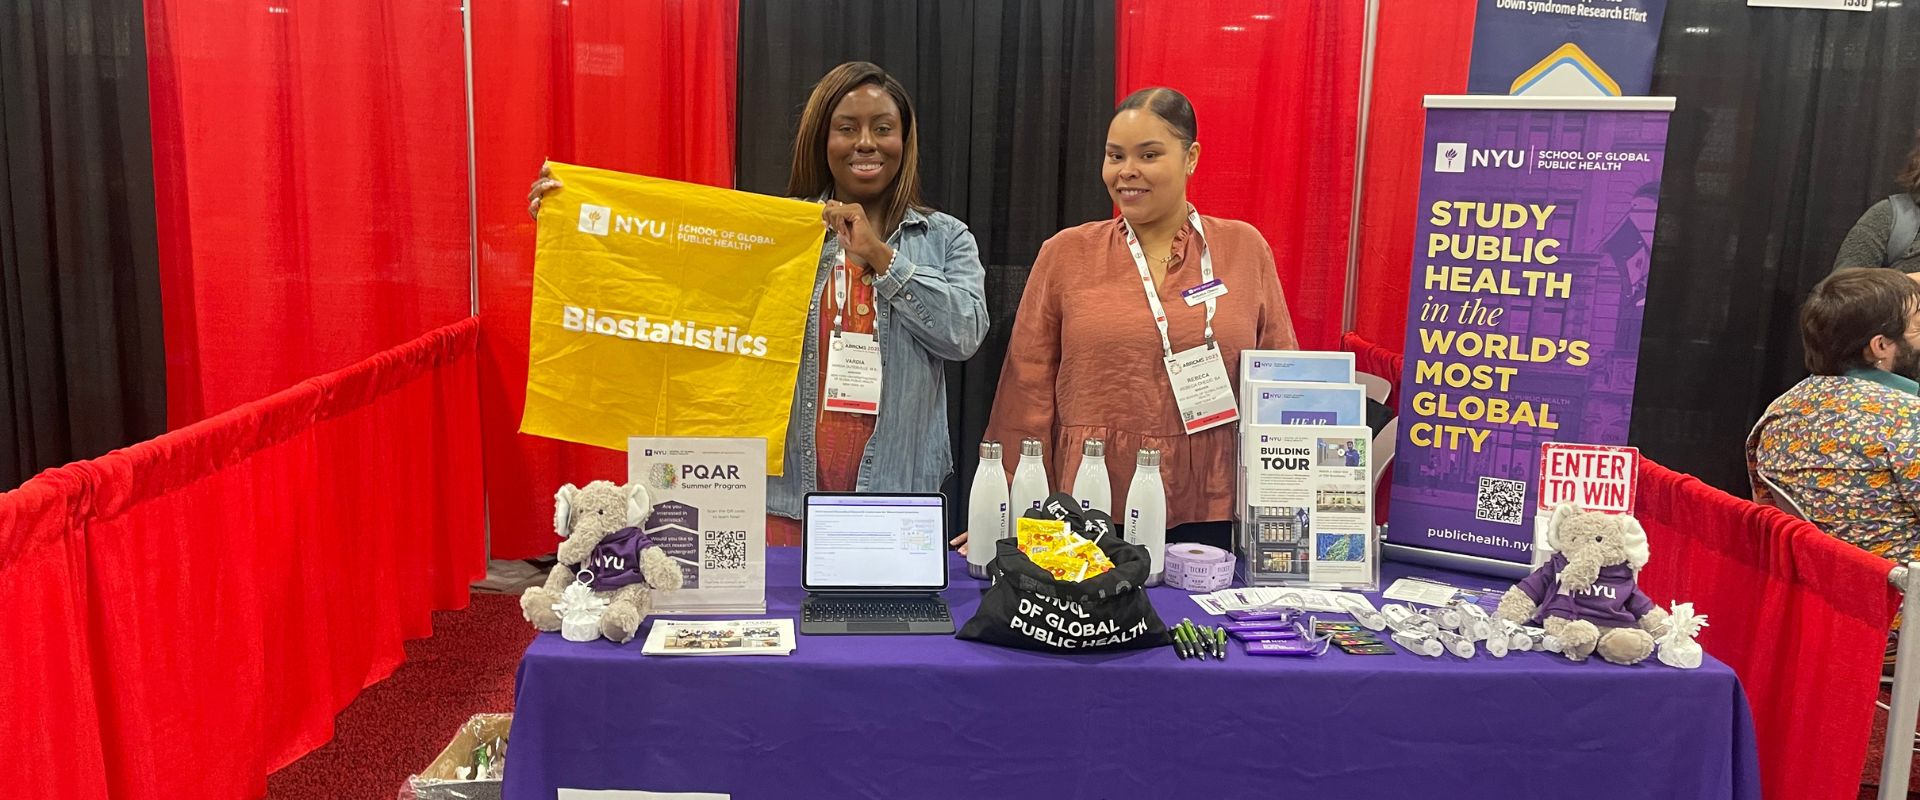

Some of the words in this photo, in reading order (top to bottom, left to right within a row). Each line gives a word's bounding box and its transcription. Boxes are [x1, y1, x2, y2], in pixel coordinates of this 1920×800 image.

[1496, 0, 1526, 10] Down
[1527, 2, 1577, 14] syndrome
[1577, 4, 1622, 19] Research
[1623, 8, 1648, 23] Effort
[1471, 149, 1525, 168] NYU
[1537, 160, 1577, 170] PUBLIC
[1579, 161, 1622, 171] HEALTH
[1538, 150, 1584, 161] SCHOOL
[1586, 151, 1602, 161] OF
[1605, 152, 1651, 162] GLOBAL
[615, 215, 665, 238] NYU
[1430, 201, 1557, 231] STUDY
[677, 233, 711, 246] PUBLIC
[714, 238, 751, 250] HEALTH
[678, 223, 718, 237] SCHOOL
[721, 230, 735, 240] OF
[737, 232, 776, 245] GLOBAL
[1428, 233, 1560, 265] PUBLIC
[1424, 265, 1572, 299] HEALTH
[1420, 296, 1449, 323] in
[1457, 298, 1504, 327] the
[563, 304, 767, 357] Biostatistics
[1415, 360, 1518, 392] MOST
[1412, 391, 1559, 430] GLOBAL
[1409, 423, 1491, 453] CITY
[1260, 447, 1310, 455] BUILDING
[1260, 457, 1310, 470] TOUR
[682, 464, 740, 480] PQAR
[1551, 452, 1626, 480] ENTER
[714, 482, 747, 491] Program
[1549, 479, 1577, 504] TO
[1583, 481, 1626, 507] WIN
[1190, 566, 1207, 574] TICKET
[1018, 598, 1043, 618] OF
[1027, 591, 1090, 618] HOOL
[1010, 615, 1077, 649] PUBLIC
[1045, 612, 1120, 637] GLOBAL
[1082, 617, 1148, 648] HEALTH
